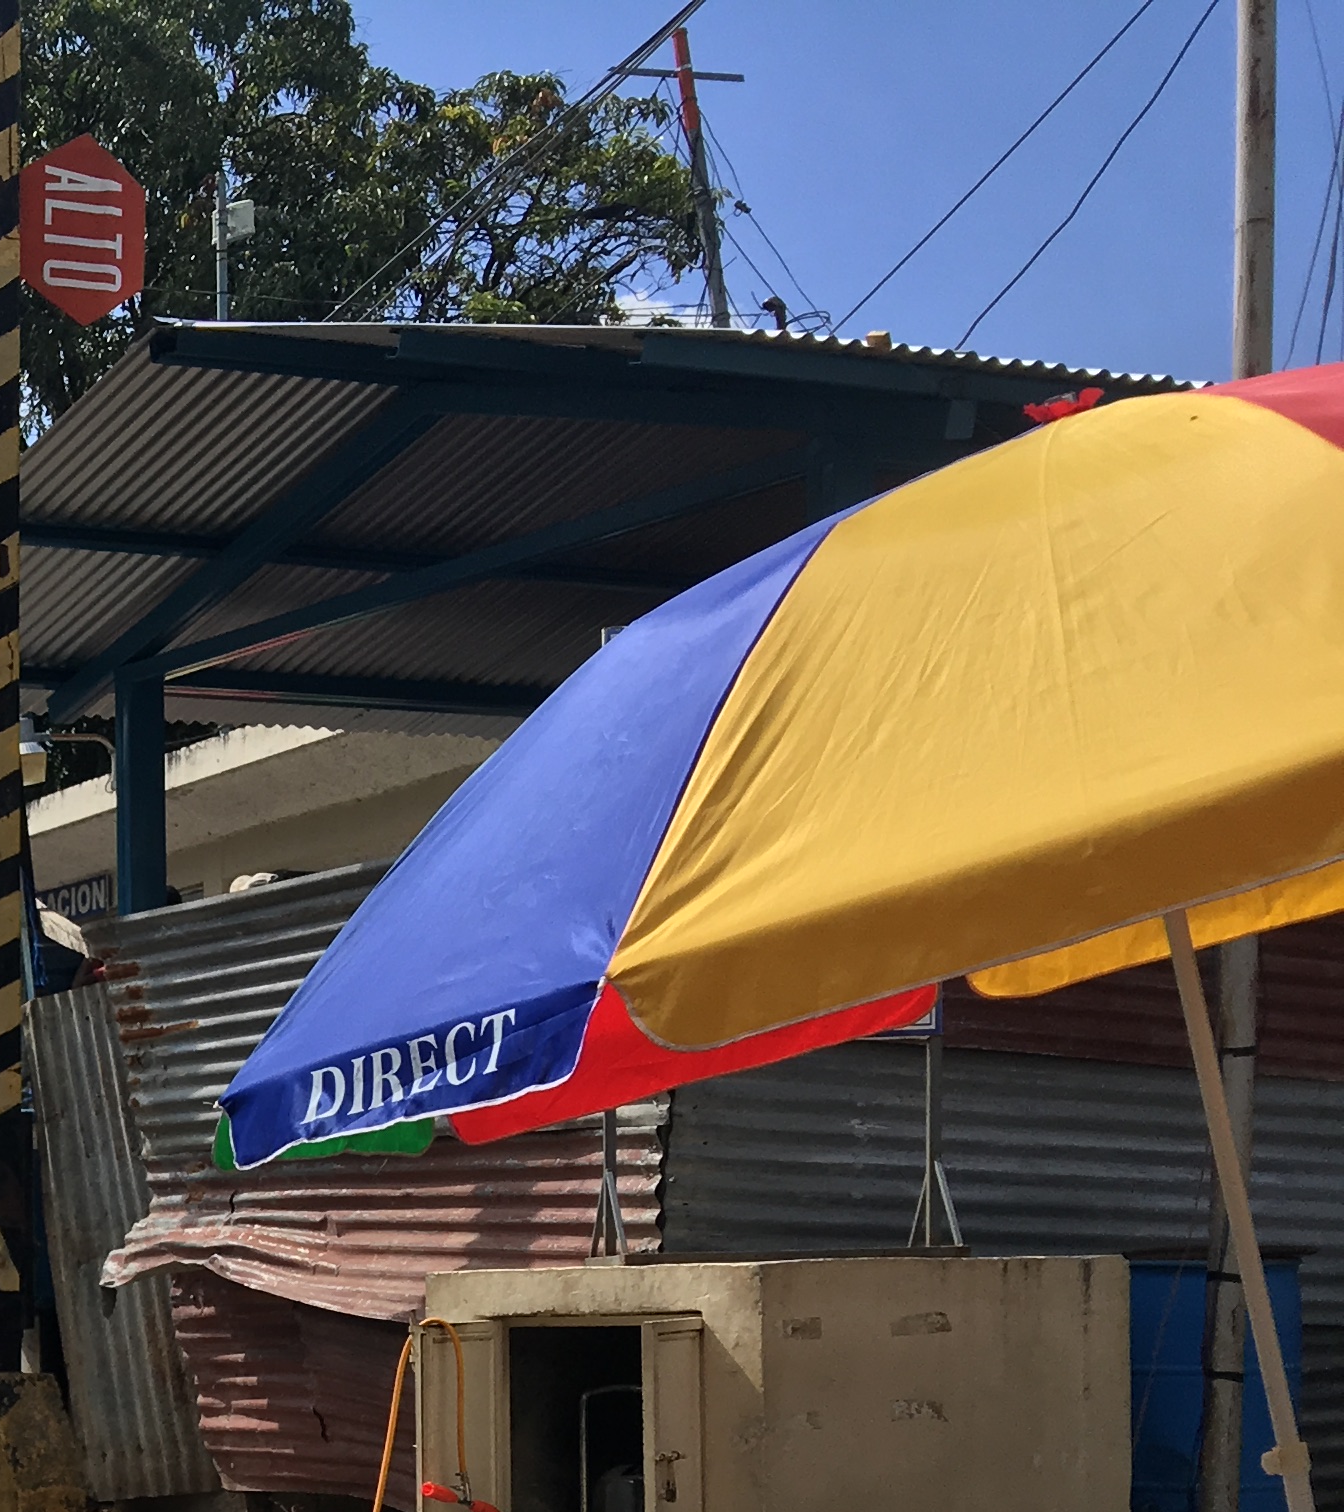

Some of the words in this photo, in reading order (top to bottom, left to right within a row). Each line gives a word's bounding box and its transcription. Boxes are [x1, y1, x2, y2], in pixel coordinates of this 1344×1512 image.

[43, 164, 123, 293] ALTO
[45, 879, 106, 917] ACION
[300, 1008, 516, 1125] DIRECT
